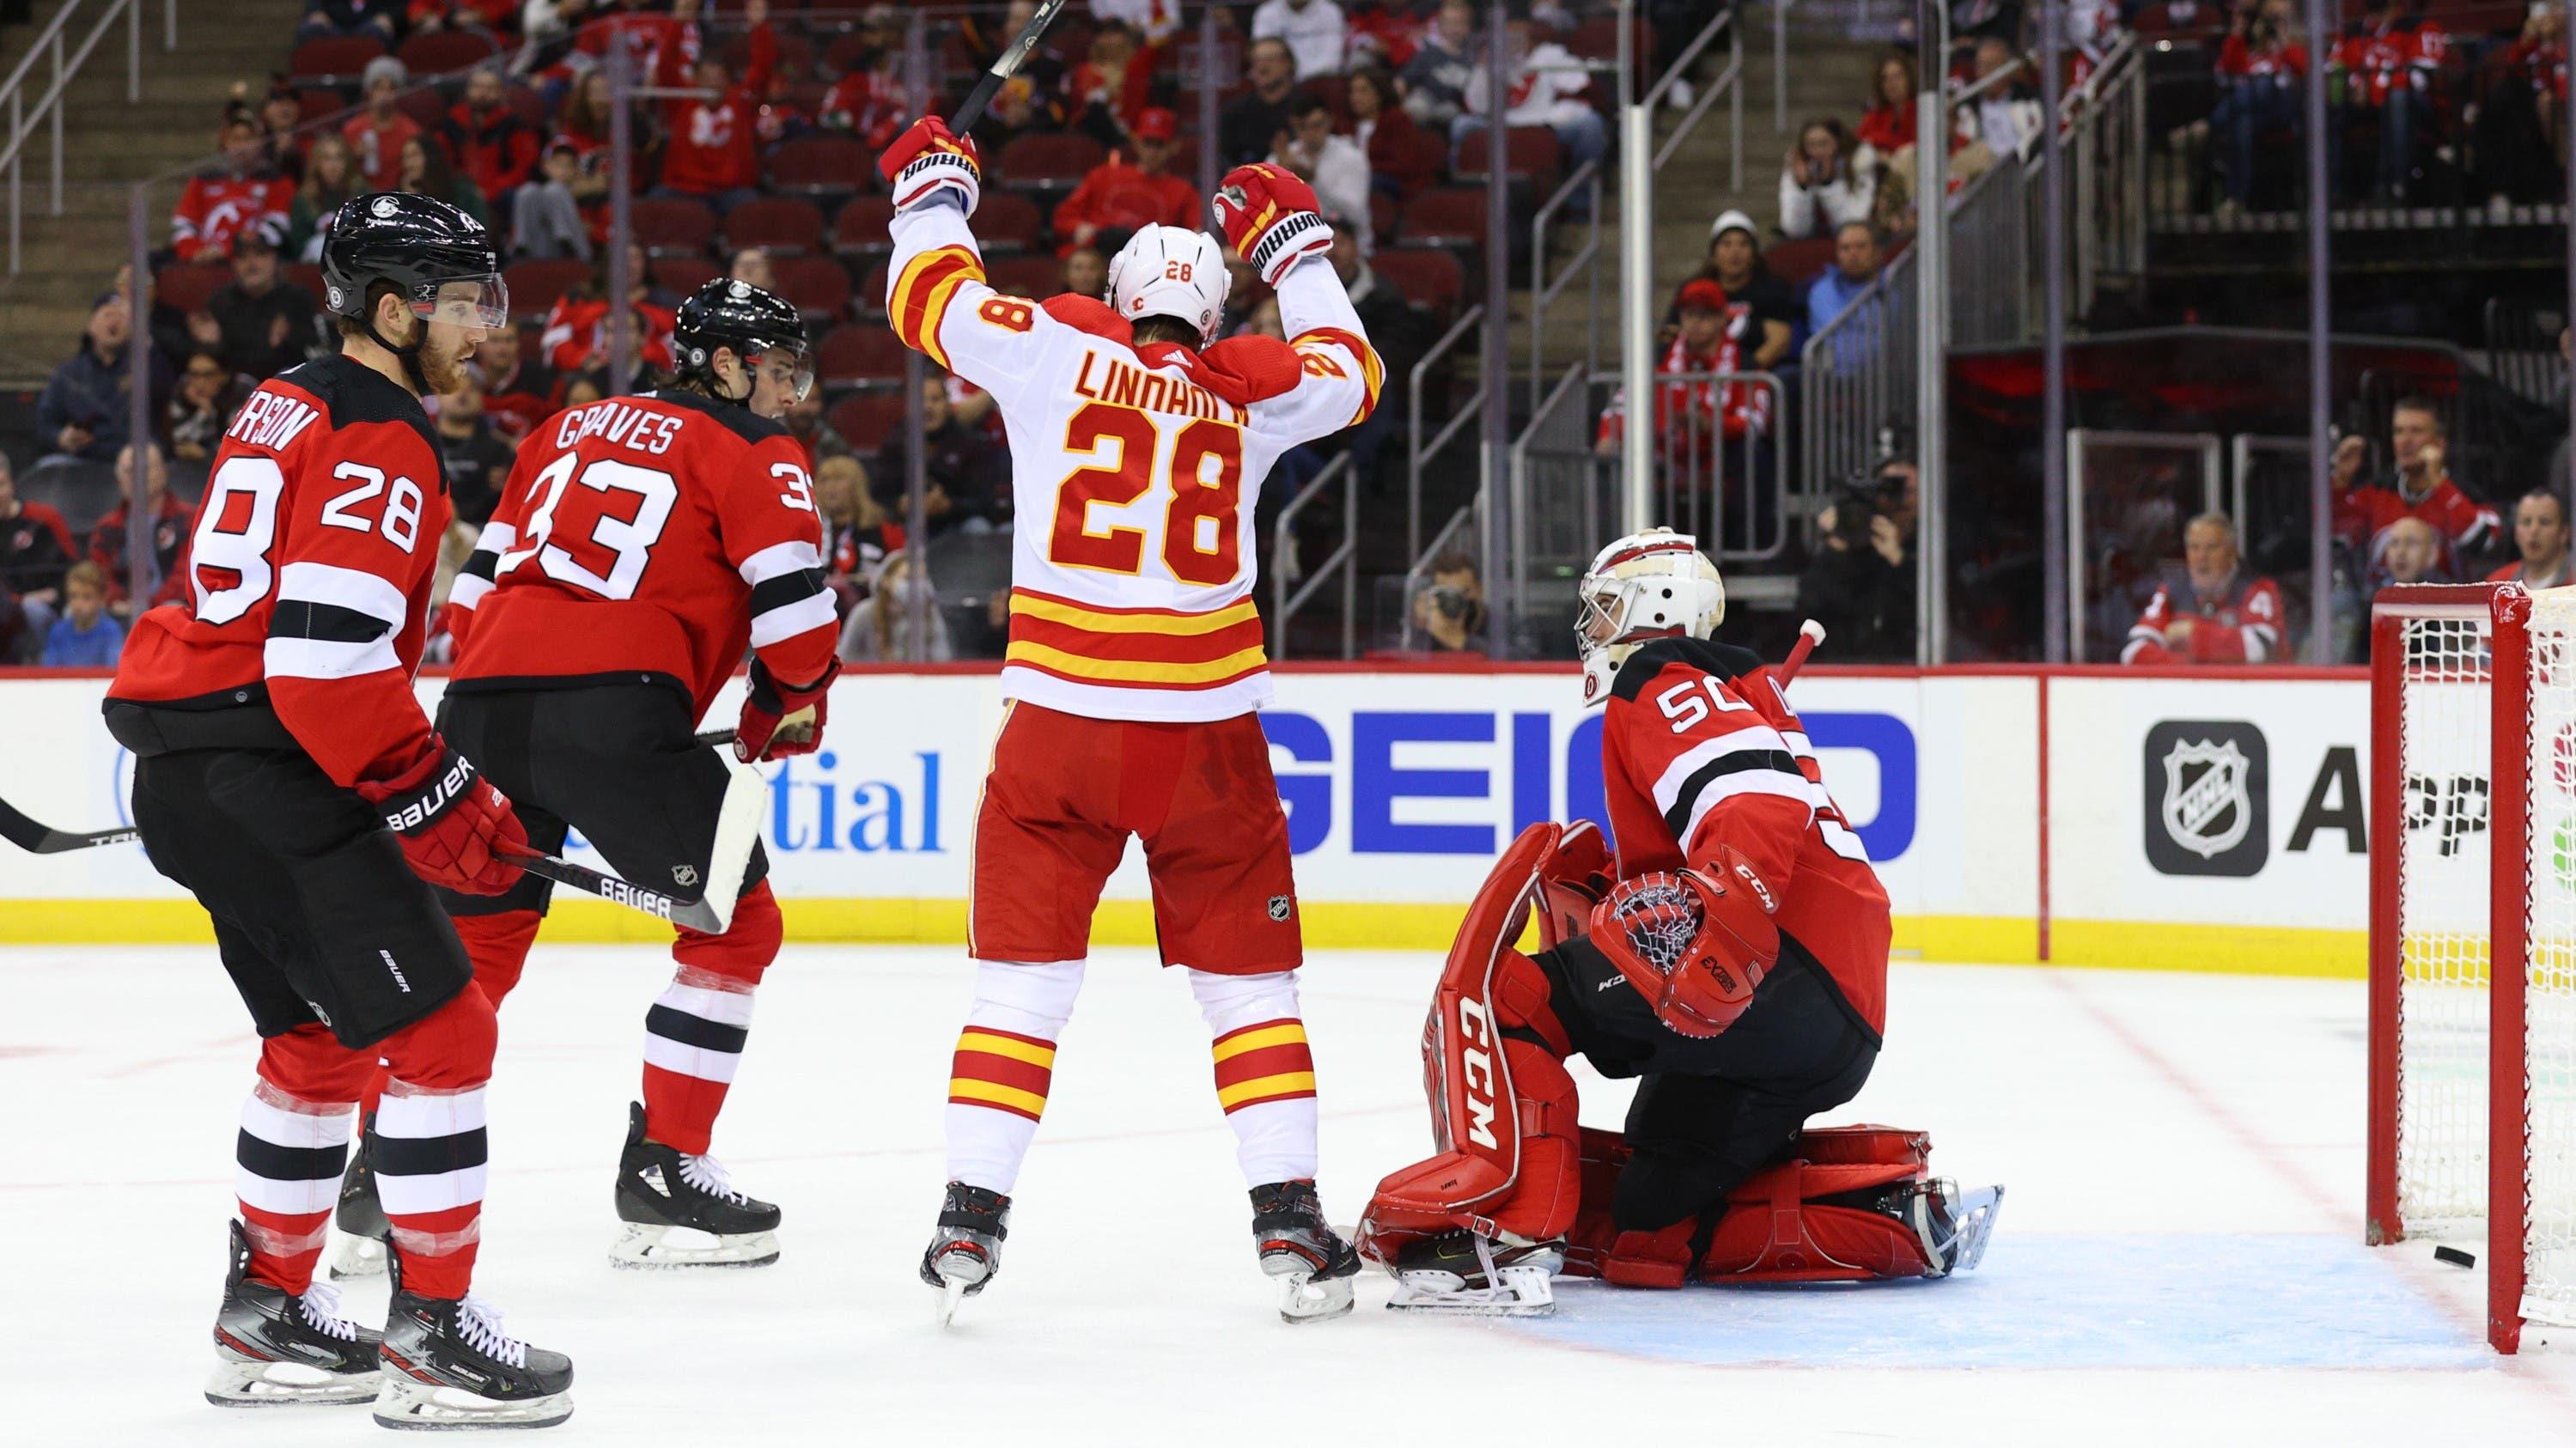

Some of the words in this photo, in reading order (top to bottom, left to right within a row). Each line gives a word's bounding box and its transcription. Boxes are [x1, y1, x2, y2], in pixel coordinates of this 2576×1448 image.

[1166, 260, 1193, 283] 28
[225, 389, 320, 453] RSON
[555, 401, 684, 455] GRAVES
[320, 460, 423, 555] 28
[770, 461, 822, 521] 3
[1047, 400, 1246, 587] 28
[494, 449, 679, 601] 33
[1655, 674, 1756, 734] 50
[387, 755, 475, 832] BAUER
[601, 877, 672, 921] BAUER
[1735, 863, 1775, 909] CCM
[379, 949, 411, 993] BAUER
[1598, 974, 1626, 992] CM
[1459, 995, 1498, 1151] CCM
